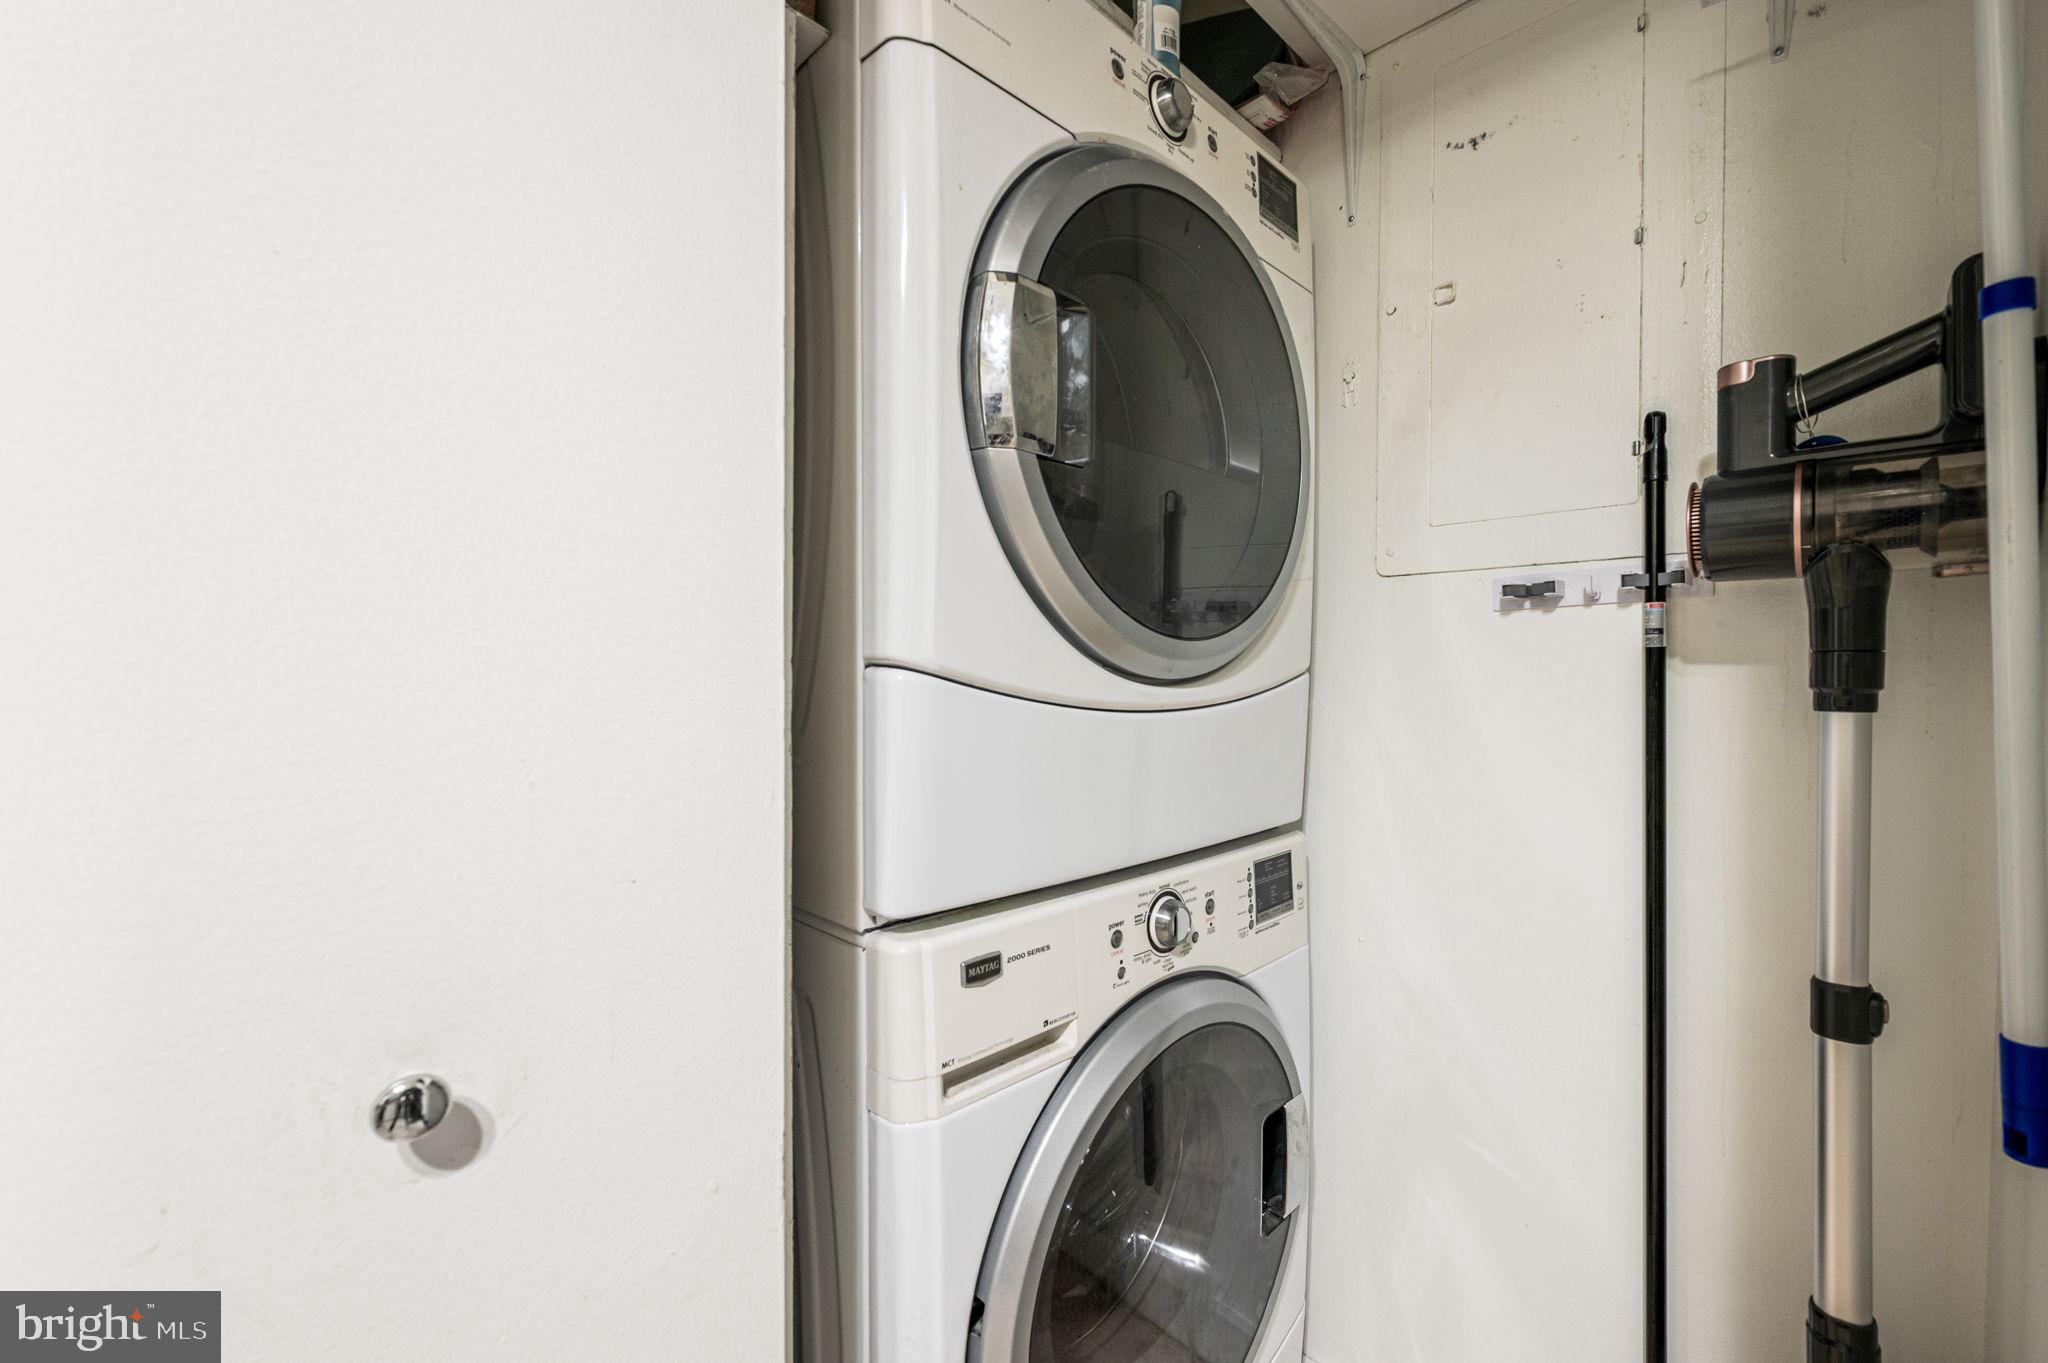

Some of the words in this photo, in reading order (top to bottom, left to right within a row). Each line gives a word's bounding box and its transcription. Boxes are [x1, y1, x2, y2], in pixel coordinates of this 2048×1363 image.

[1204, 889, 1215, 899] start
[1108, 920, 1125, 931] power
[1006, 952, 1026, 964] 2000
[1026, 944, 1051, 957] SERIES
[968, 960, 1000, 978] MAYTAG
[941, 1058, 955, 1070] MCT
